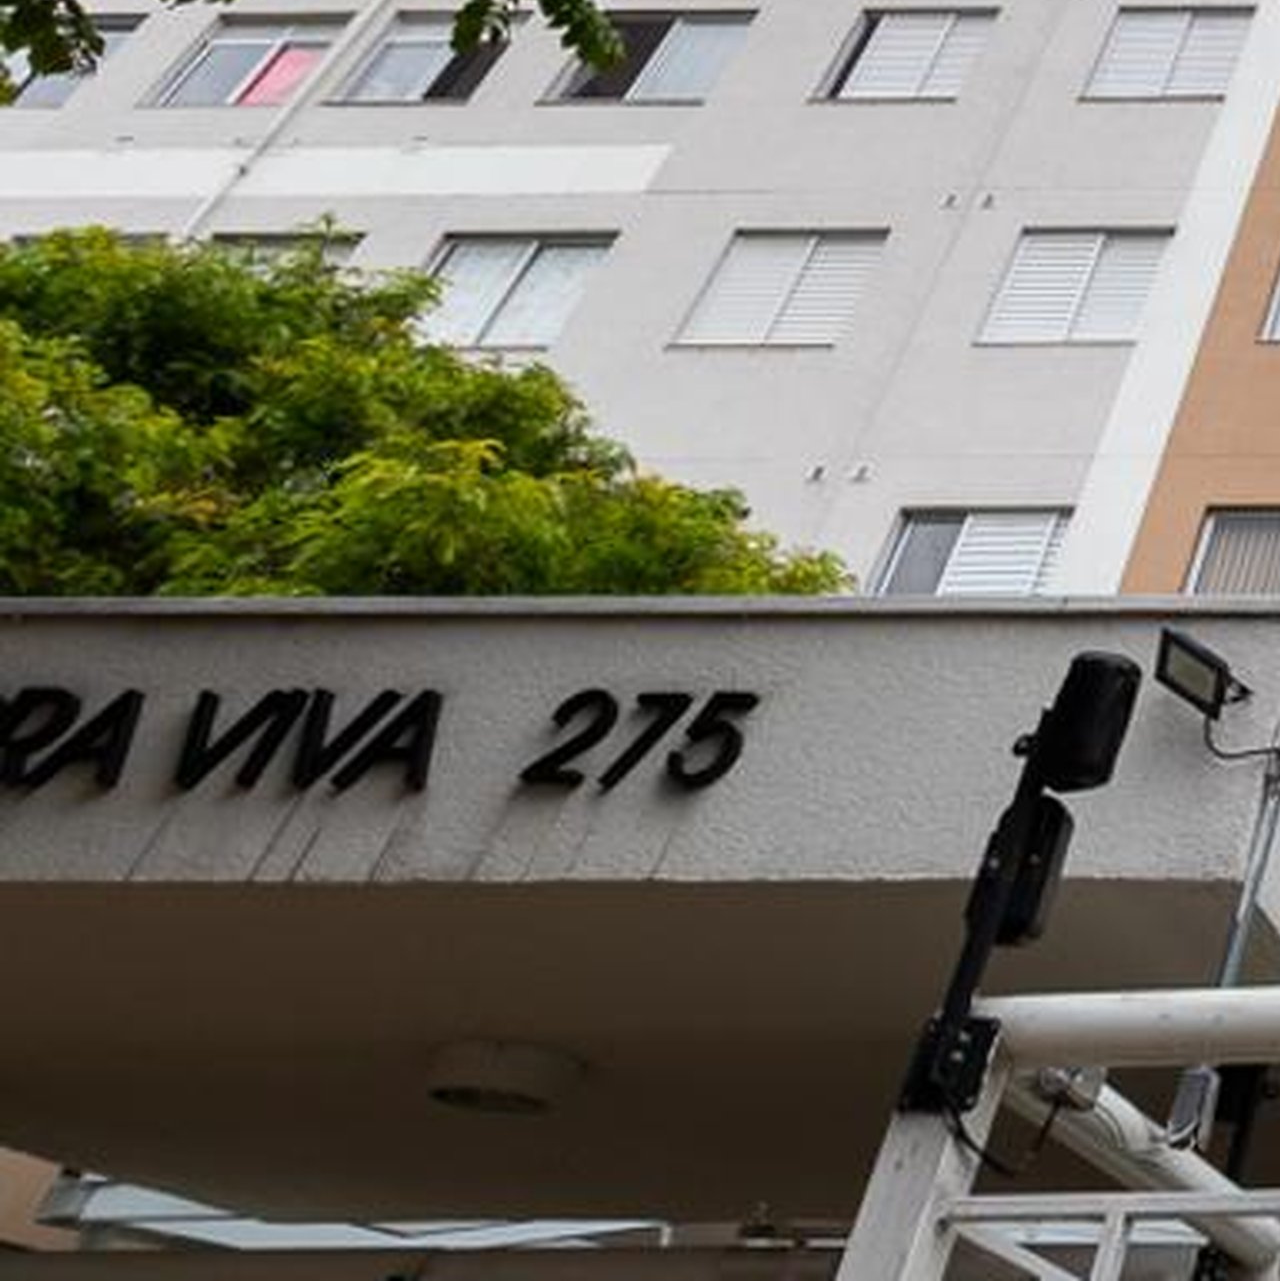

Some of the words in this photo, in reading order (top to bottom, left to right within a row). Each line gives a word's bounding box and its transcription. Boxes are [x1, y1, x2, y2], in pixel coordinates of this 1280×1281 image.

[0, 686, 145, 796] RA
[173, 688, 443, 795] VIVA
[519, 689, 759, 795] 275
